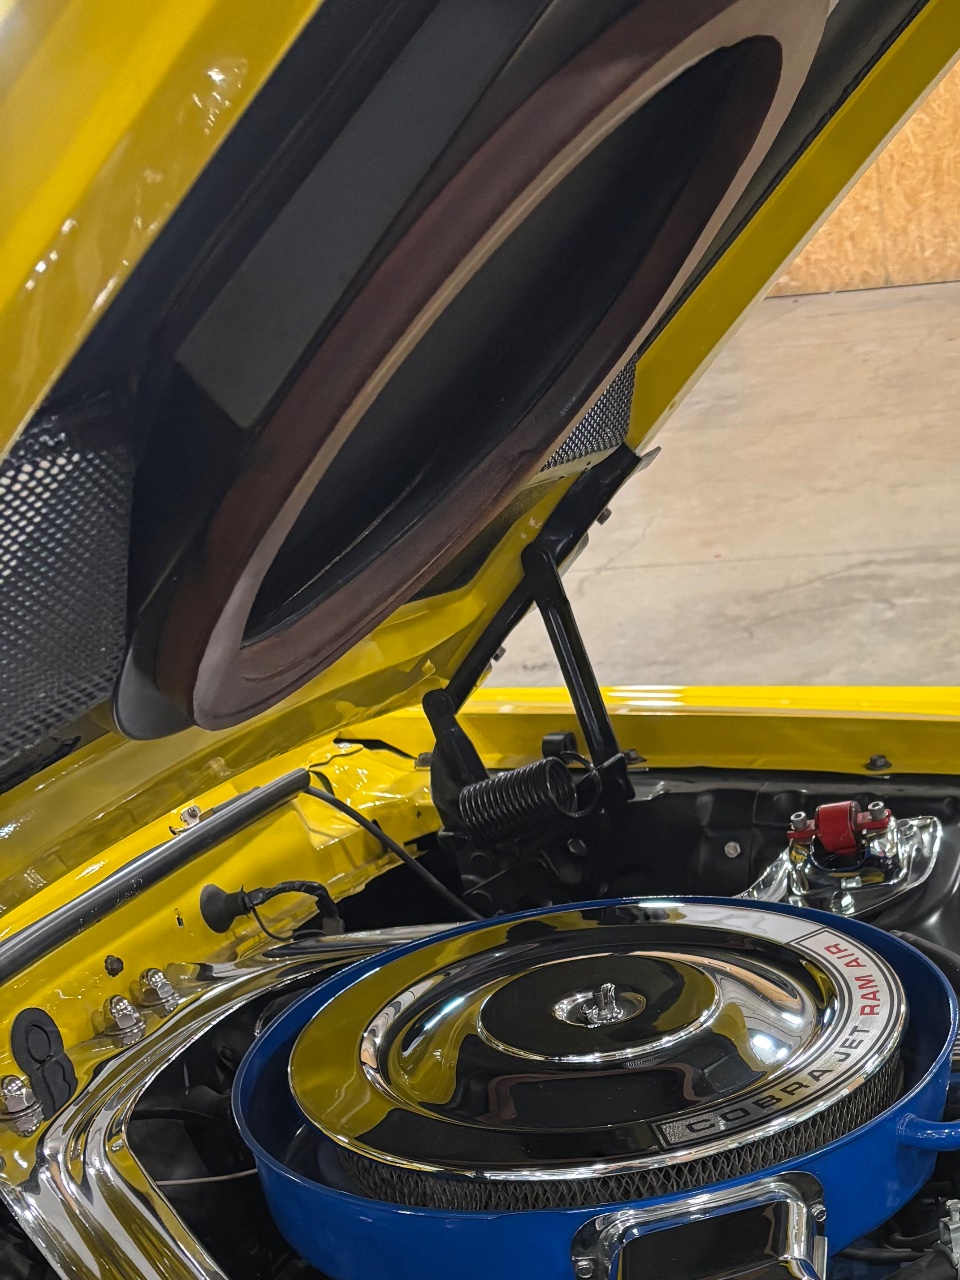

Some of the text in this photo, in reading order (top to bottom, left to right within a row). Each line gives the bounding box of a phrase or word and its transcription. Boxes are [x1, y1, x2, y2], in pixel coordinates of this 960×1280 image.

[685, 942, 881, 1134] COBRA JET RAM AIR
